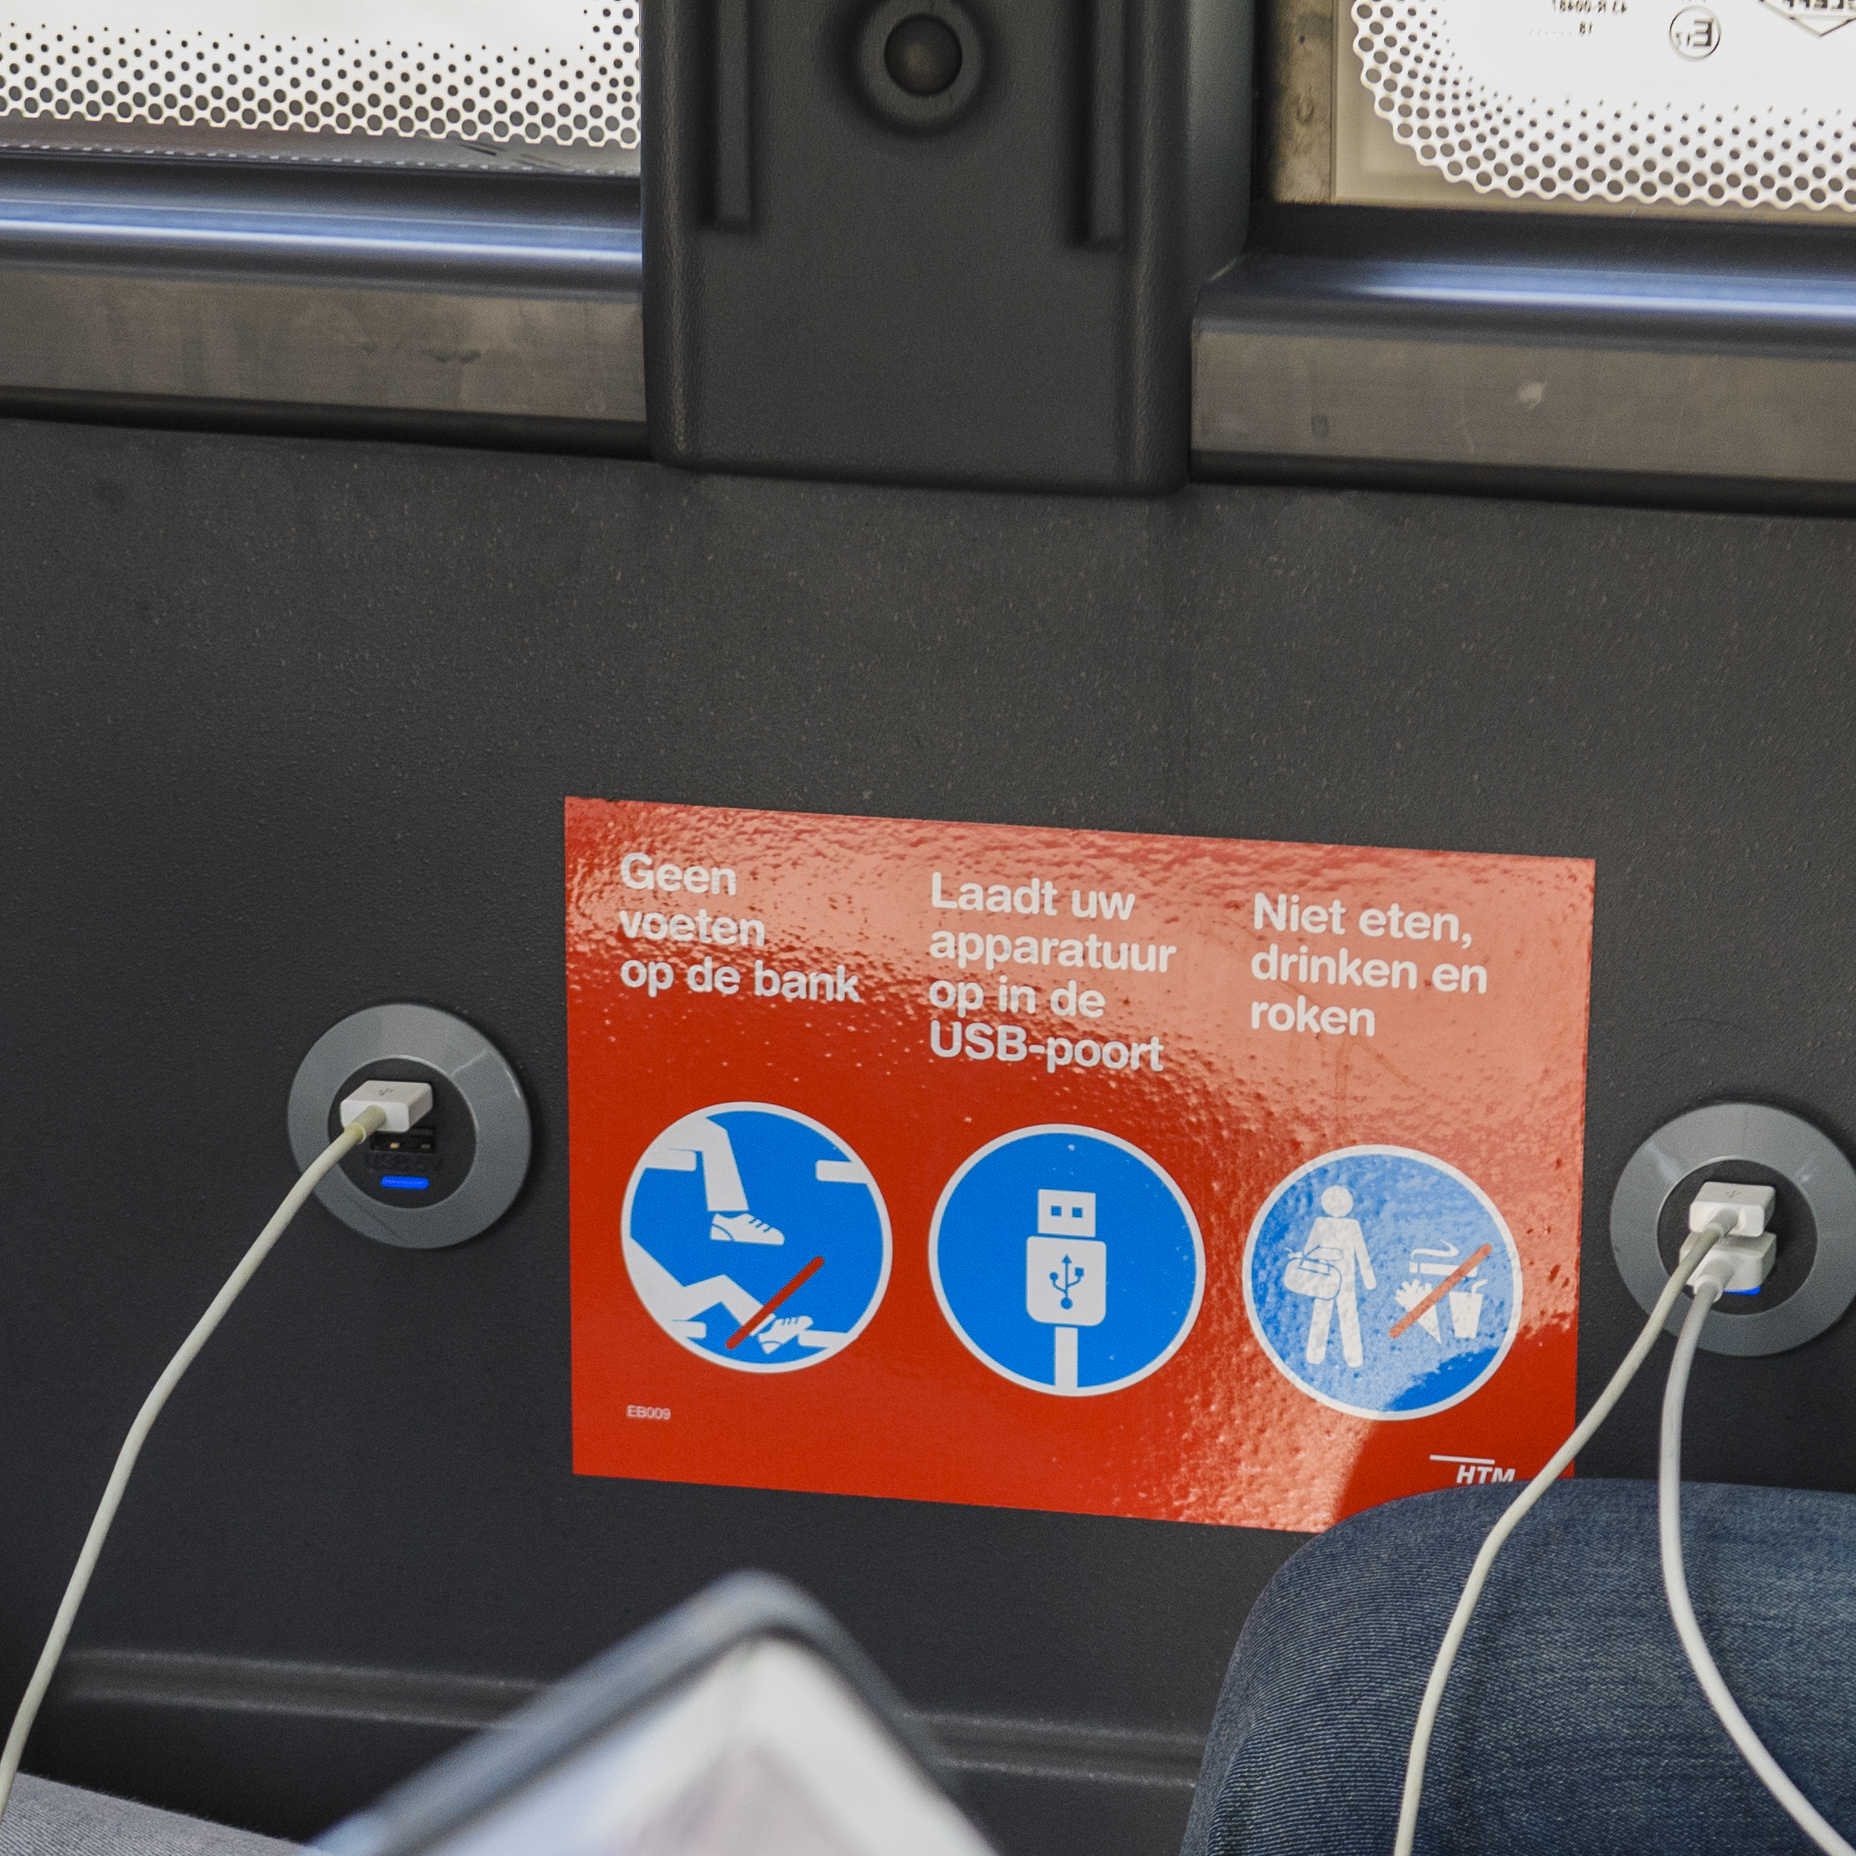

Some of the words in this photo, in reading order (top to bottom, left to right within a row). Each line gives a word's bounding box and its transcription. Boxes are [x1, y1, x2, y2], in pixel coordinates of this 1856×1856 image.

[620, 852, 737, 896] Geen
[931, 871, 1059, 916] Laadt
[1071, 889, 1136, 921] uw
[618, 908, 766, 947] voeten
[1253, 892, 1346, 935] Niet
[1358, 902, 1473, 949] eten,
[929, 930, 1177, 973] apparatuur
[1250, 943, 1418, 990] drinken
[1432, 963, 1488, 994] en
[620, 959, 675, 998] op
[686, 955, 742, 994] de
[754, 959, 861, 1003] bank
[929, 979, 985, 1018] op
[998, 974, 1036, 1014] in
[1050, 979, 1106, 1018] de
[1250, 995, 1376, 1037] roken
[930, 1020, 1164, 1074] USB-poort
[626, 1404, 672, 1420] EB009
[1456, 1464, 1516, 1484] HTM
